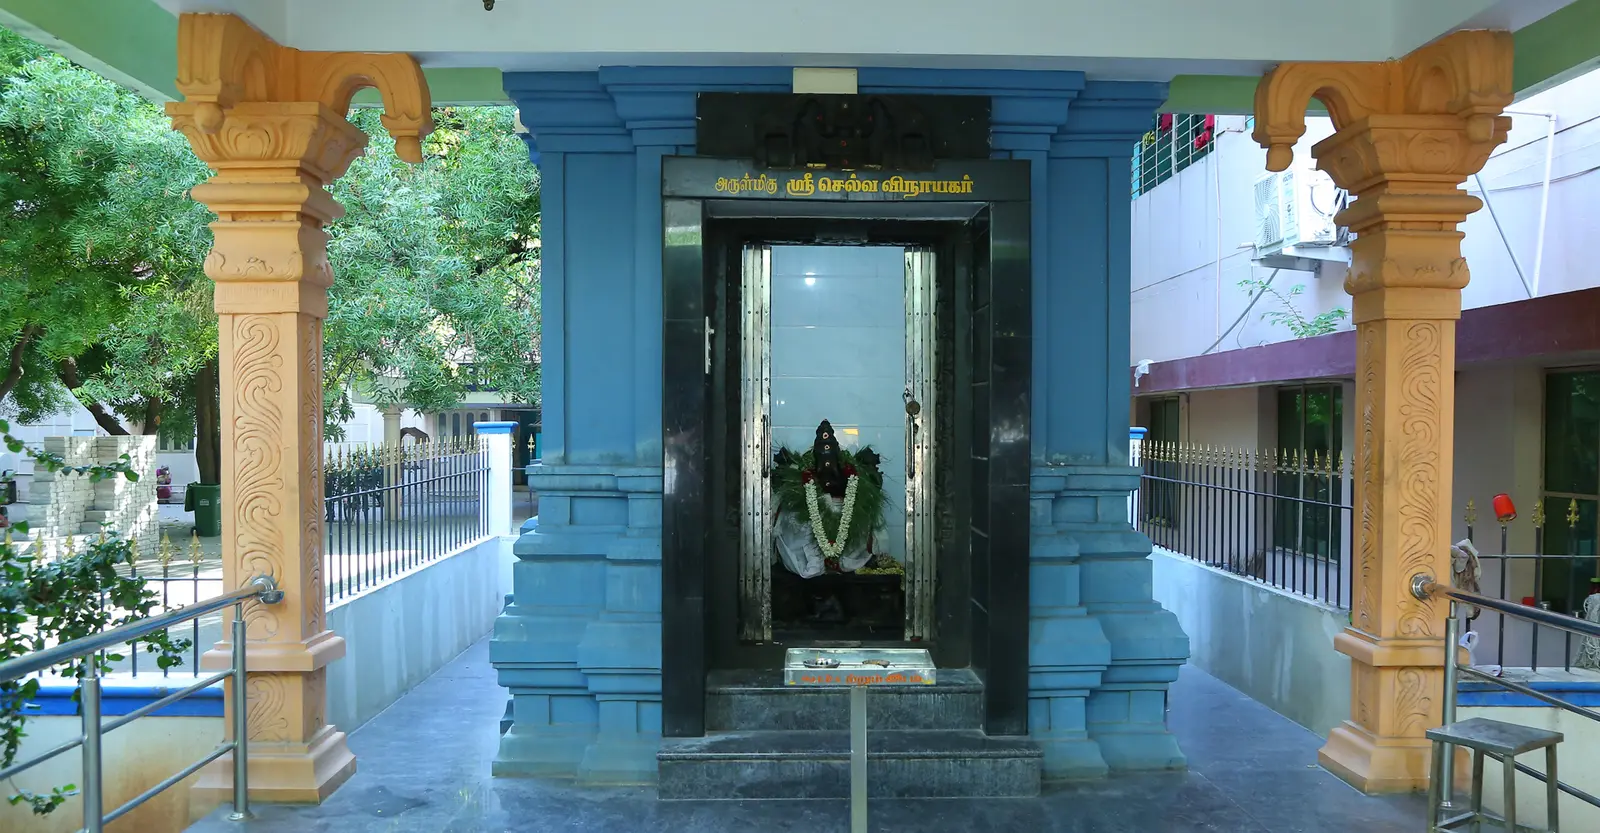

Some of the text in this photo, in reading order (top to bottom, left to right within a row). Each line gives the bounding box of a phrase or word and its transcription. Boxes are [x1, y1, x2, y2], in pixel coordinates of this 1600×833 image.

[715, 172, 777, 194] அருள்மிகு
[818, 173, 879, 193] செல்வ
[881, 174, 974, 198] விநாயகர்
